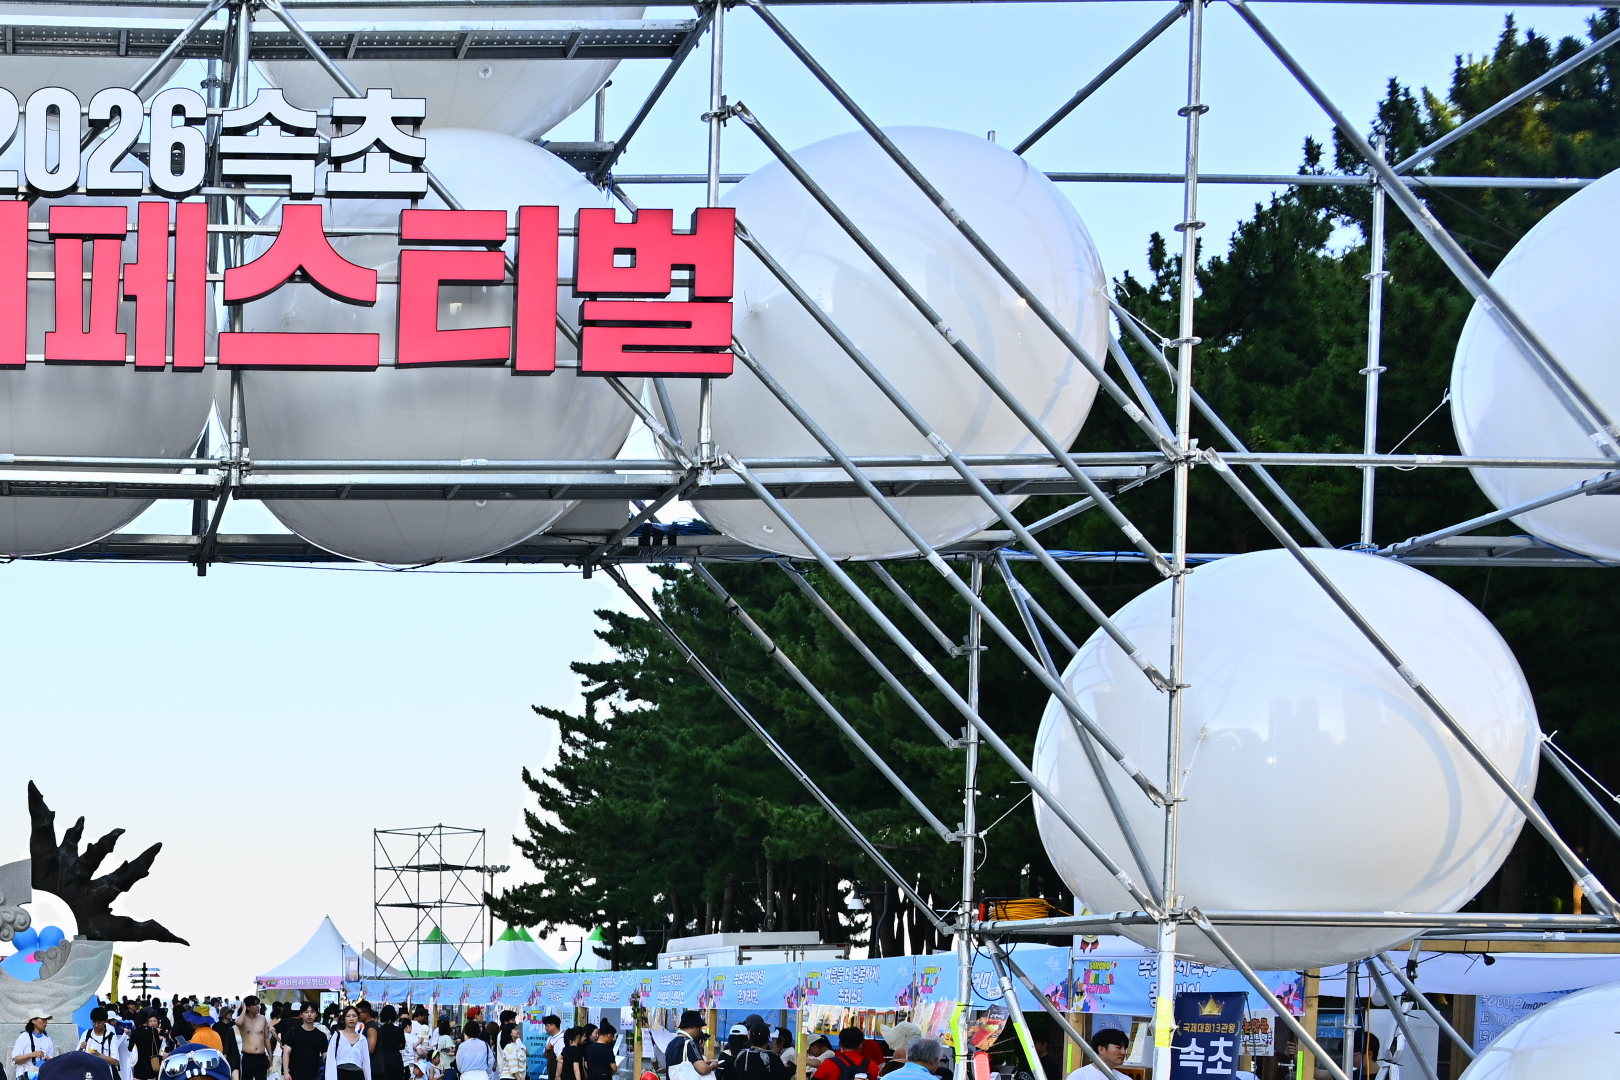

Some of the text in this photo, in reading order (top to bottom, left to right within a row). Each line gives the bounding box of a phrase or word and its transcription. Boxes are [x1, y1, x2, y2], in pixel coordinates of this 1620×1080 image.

[216, 85, 430, 200] 속초
[824, 965, 844, 985] 여름을
[844, 965, 852, 983] 더
[1182, 1022, 1236, 1034] 국제대회13관왕
[1177, 1036, 1234, 1076] 속초
